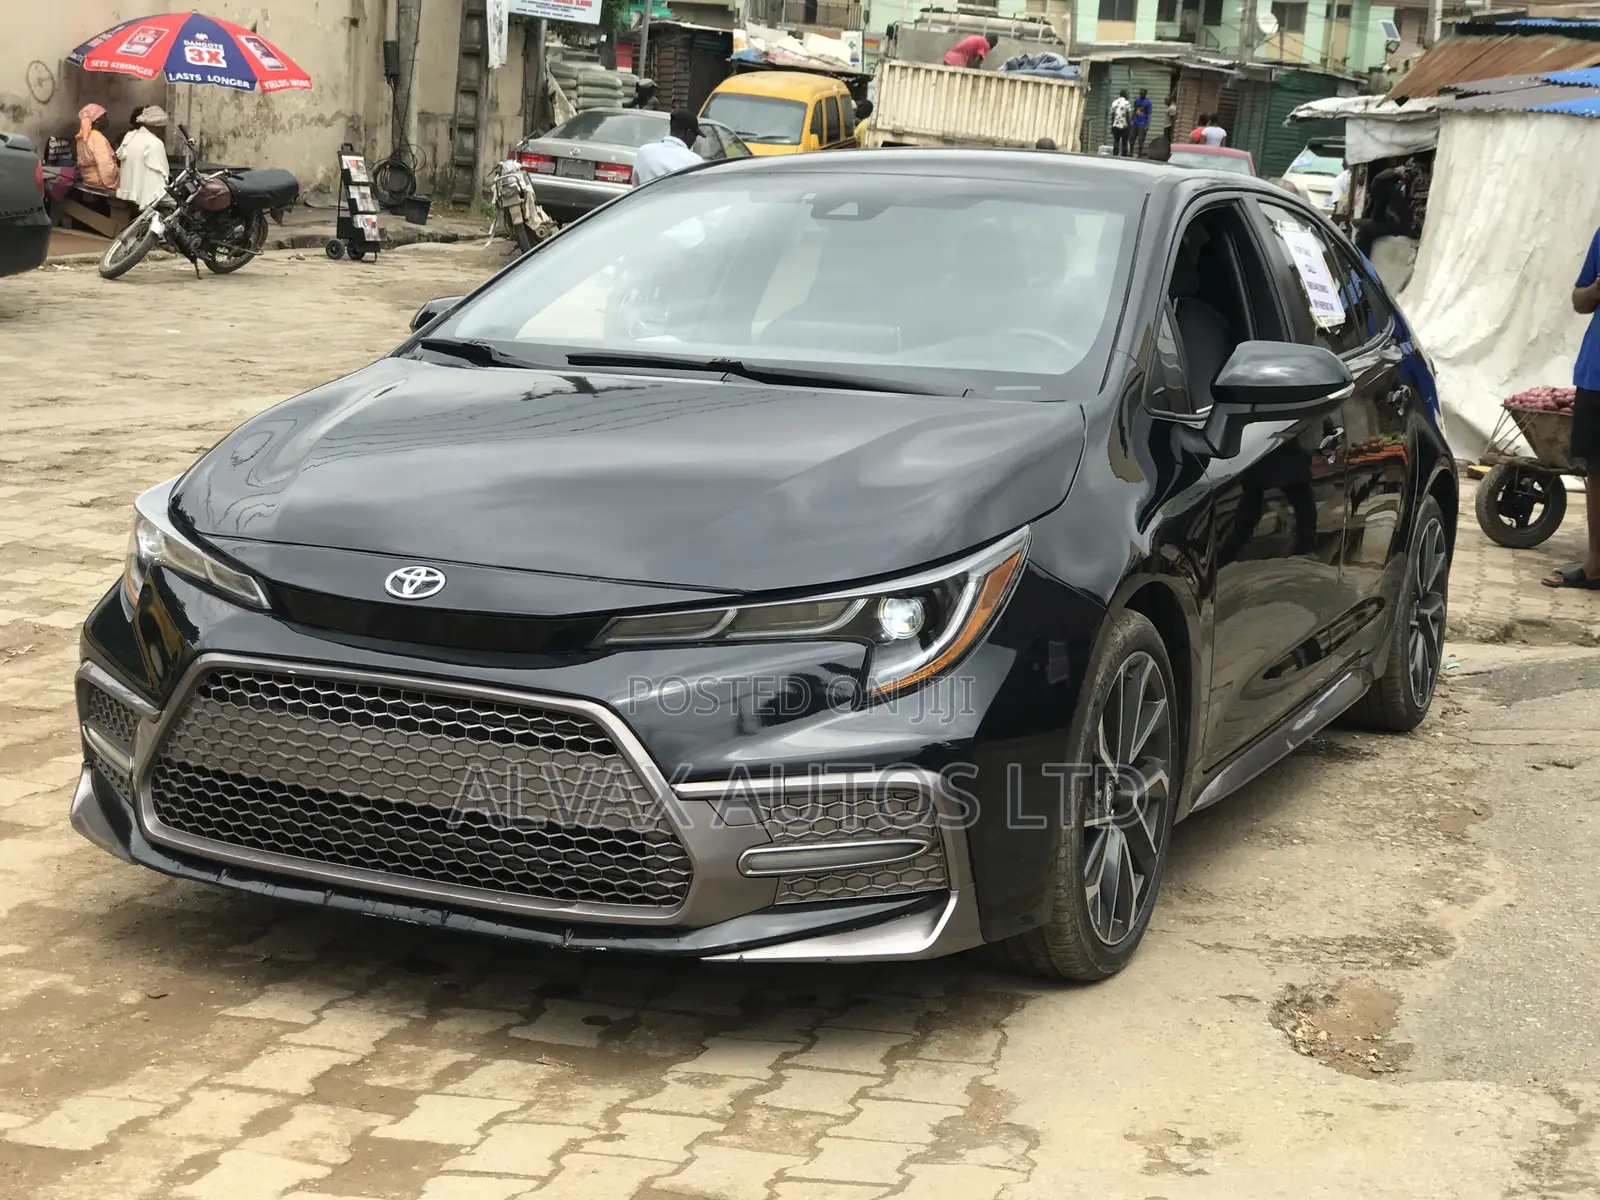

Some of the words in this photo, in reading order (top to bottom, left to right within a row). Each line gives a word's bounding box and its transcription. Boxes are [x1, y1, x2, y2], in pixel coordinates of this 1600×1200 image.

[183, 40, 223, 50] DANGOTE
[188, 48, 223, 65] 3X
[90, 60, 109, 68] SETS
[110, 61, 154, 77] STRONGER
[168, 72, 202, 82] LASTS
[207, 74, 250, 89] LONGER
[263, 79, 289, 90] YIELDS
